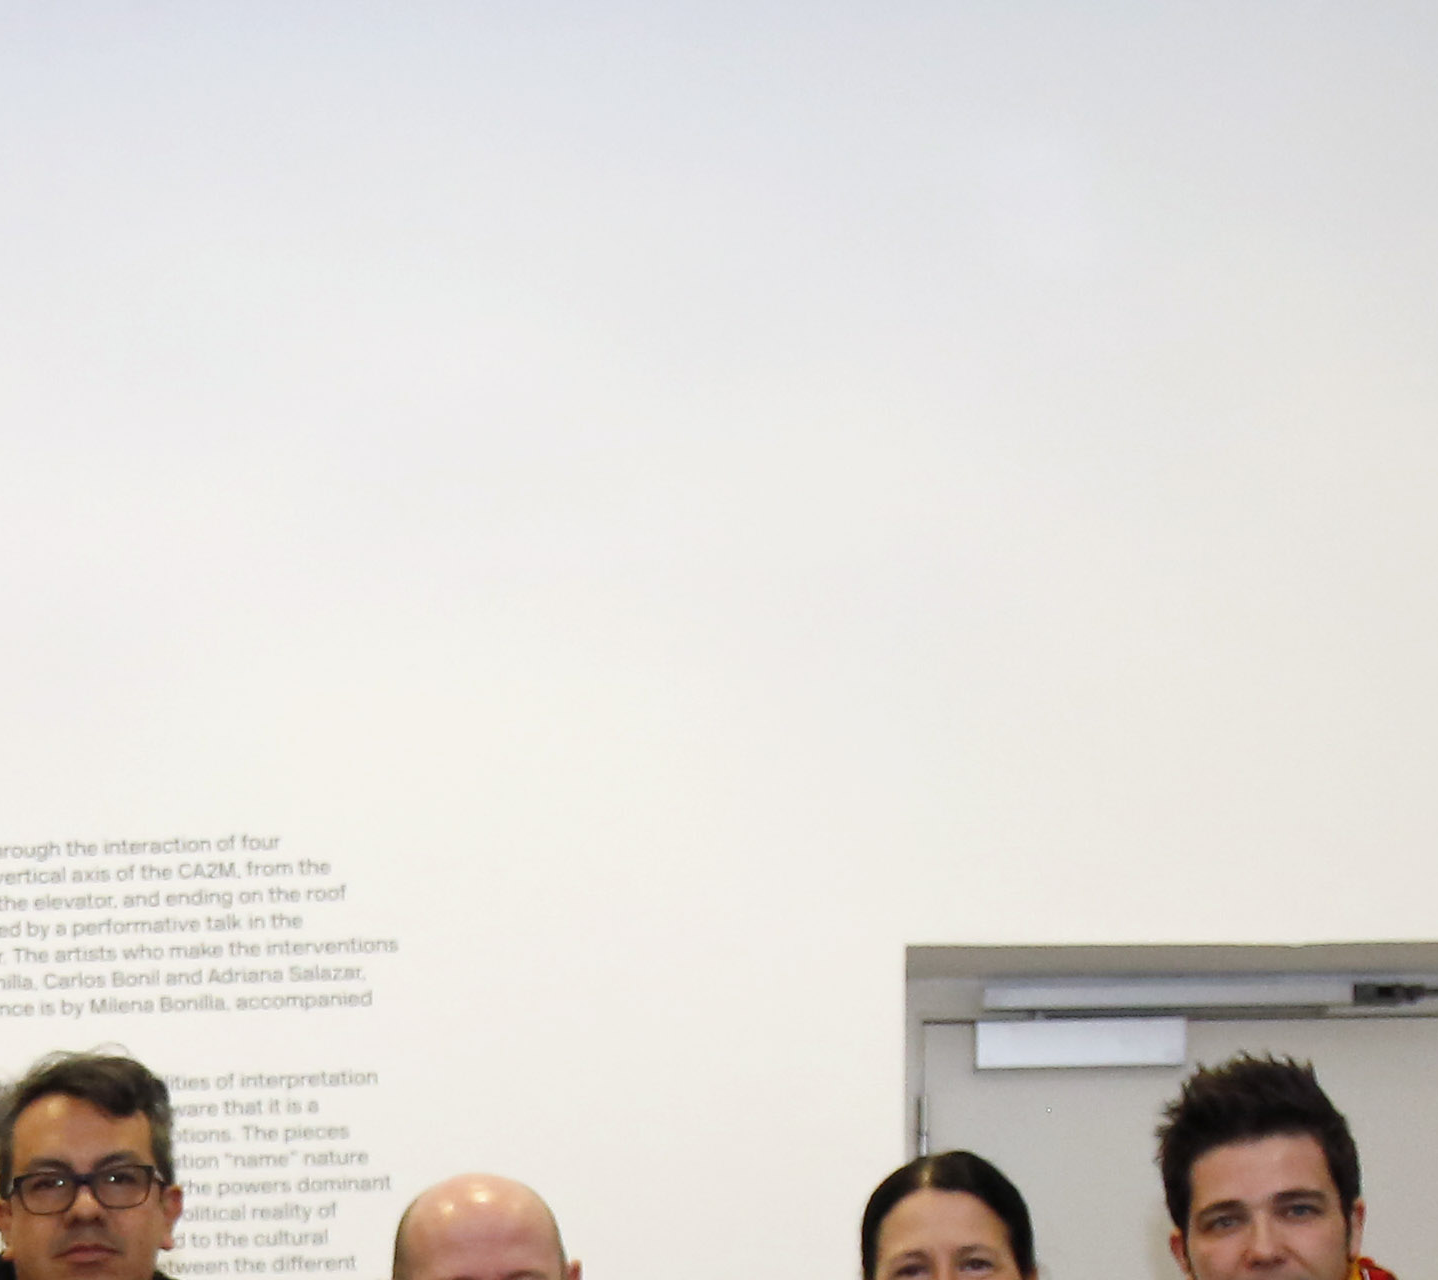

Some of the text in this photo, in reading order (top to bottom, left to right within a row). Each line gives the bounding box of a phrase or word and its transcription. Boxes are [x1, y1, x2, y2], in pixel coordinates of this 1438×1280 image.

[65, 839, 98, 857] the
[102, 836, 211, 855] interaction
[216, 835, 236, 852] of
[240, 835, 280, 851] four
[71, 866, 110, 884] axis
[115, 863, 135, 882] of
[140, 864, 172, 881] the
[245, 860, 293, 877] from
[297, 858, 331, 876] the
[122, 890, 160, 909] and
[164, 888, 233, 909] ending
[238, 889, 263, 905] on
[268, 885, 301, 905] the
[305, 884, 346, 902] roof
